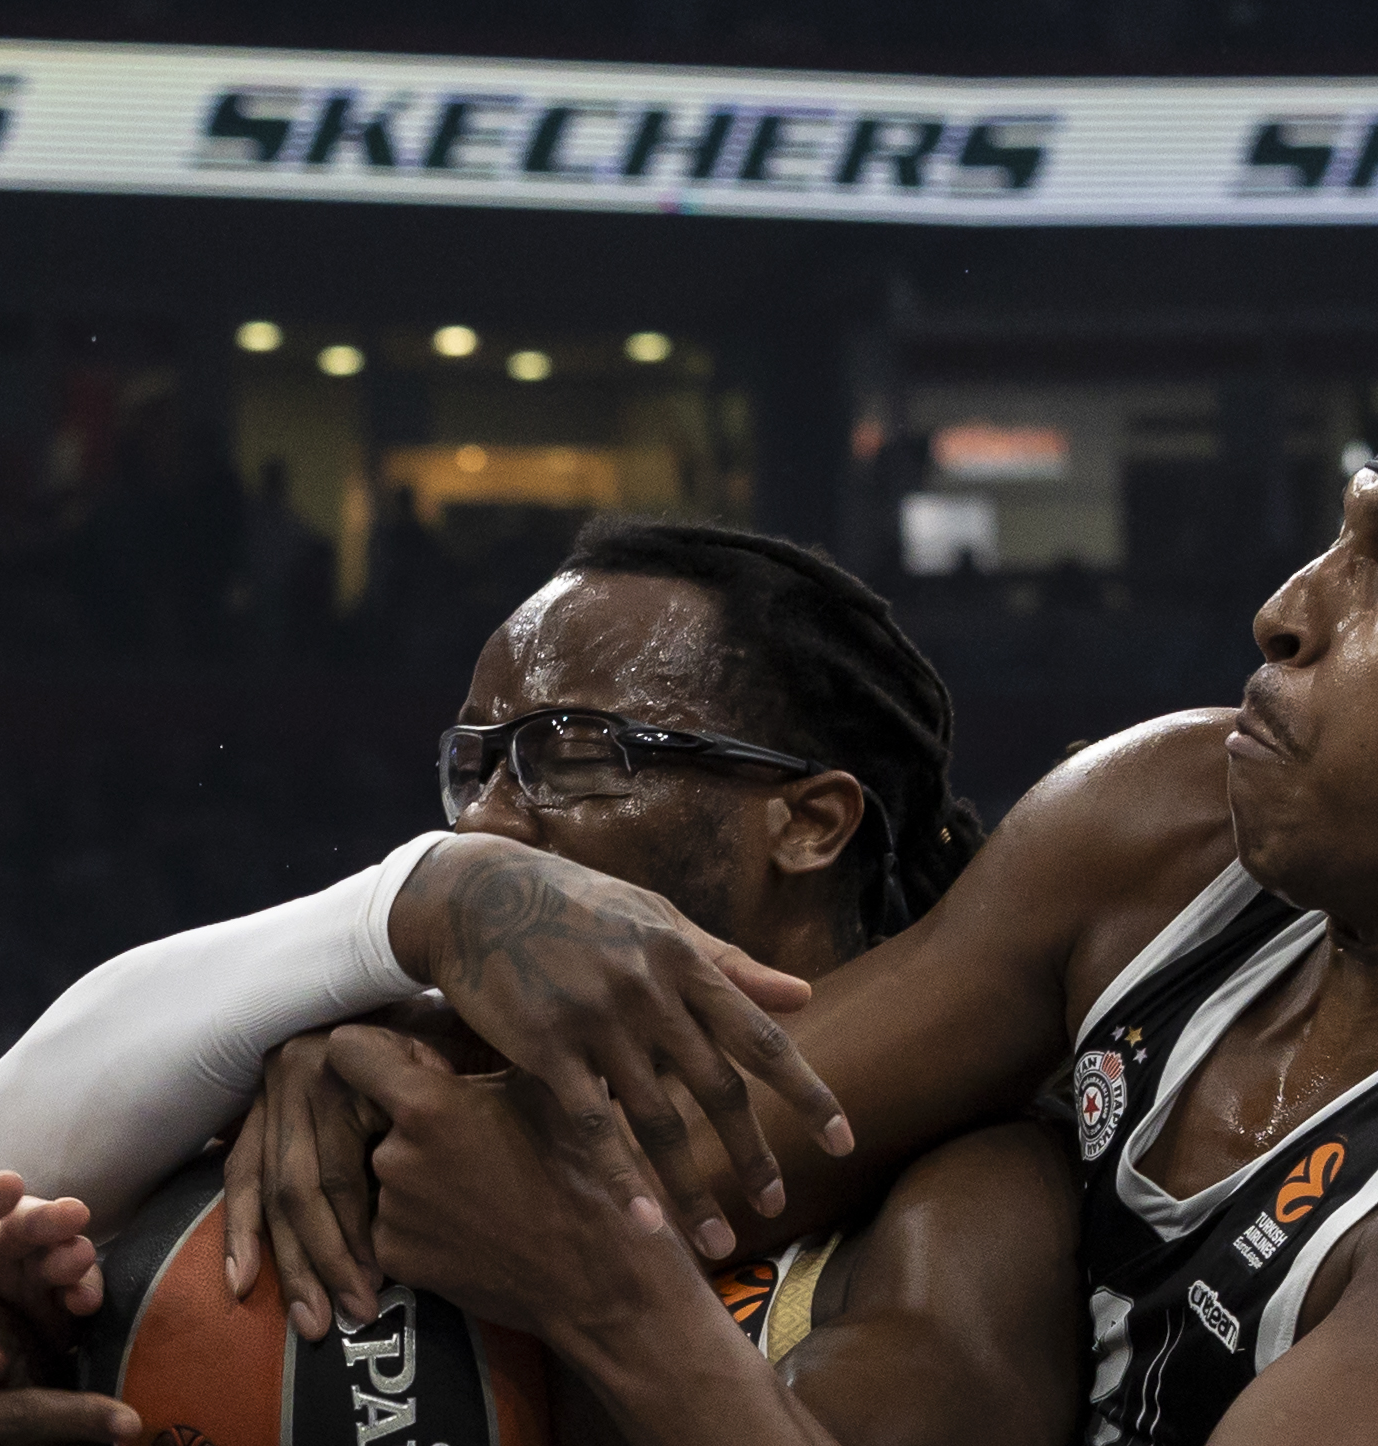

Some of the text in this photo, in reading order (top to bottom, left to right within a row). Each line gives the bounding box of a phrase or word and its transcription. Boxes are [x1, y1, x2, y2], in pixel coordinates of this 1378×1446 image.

[190, 86, 1064, 196] SKECHERS
[1243, 1224, 1277, 1260] AIRLINES
[1255, 1211, 1288, 1247] TURKISH
